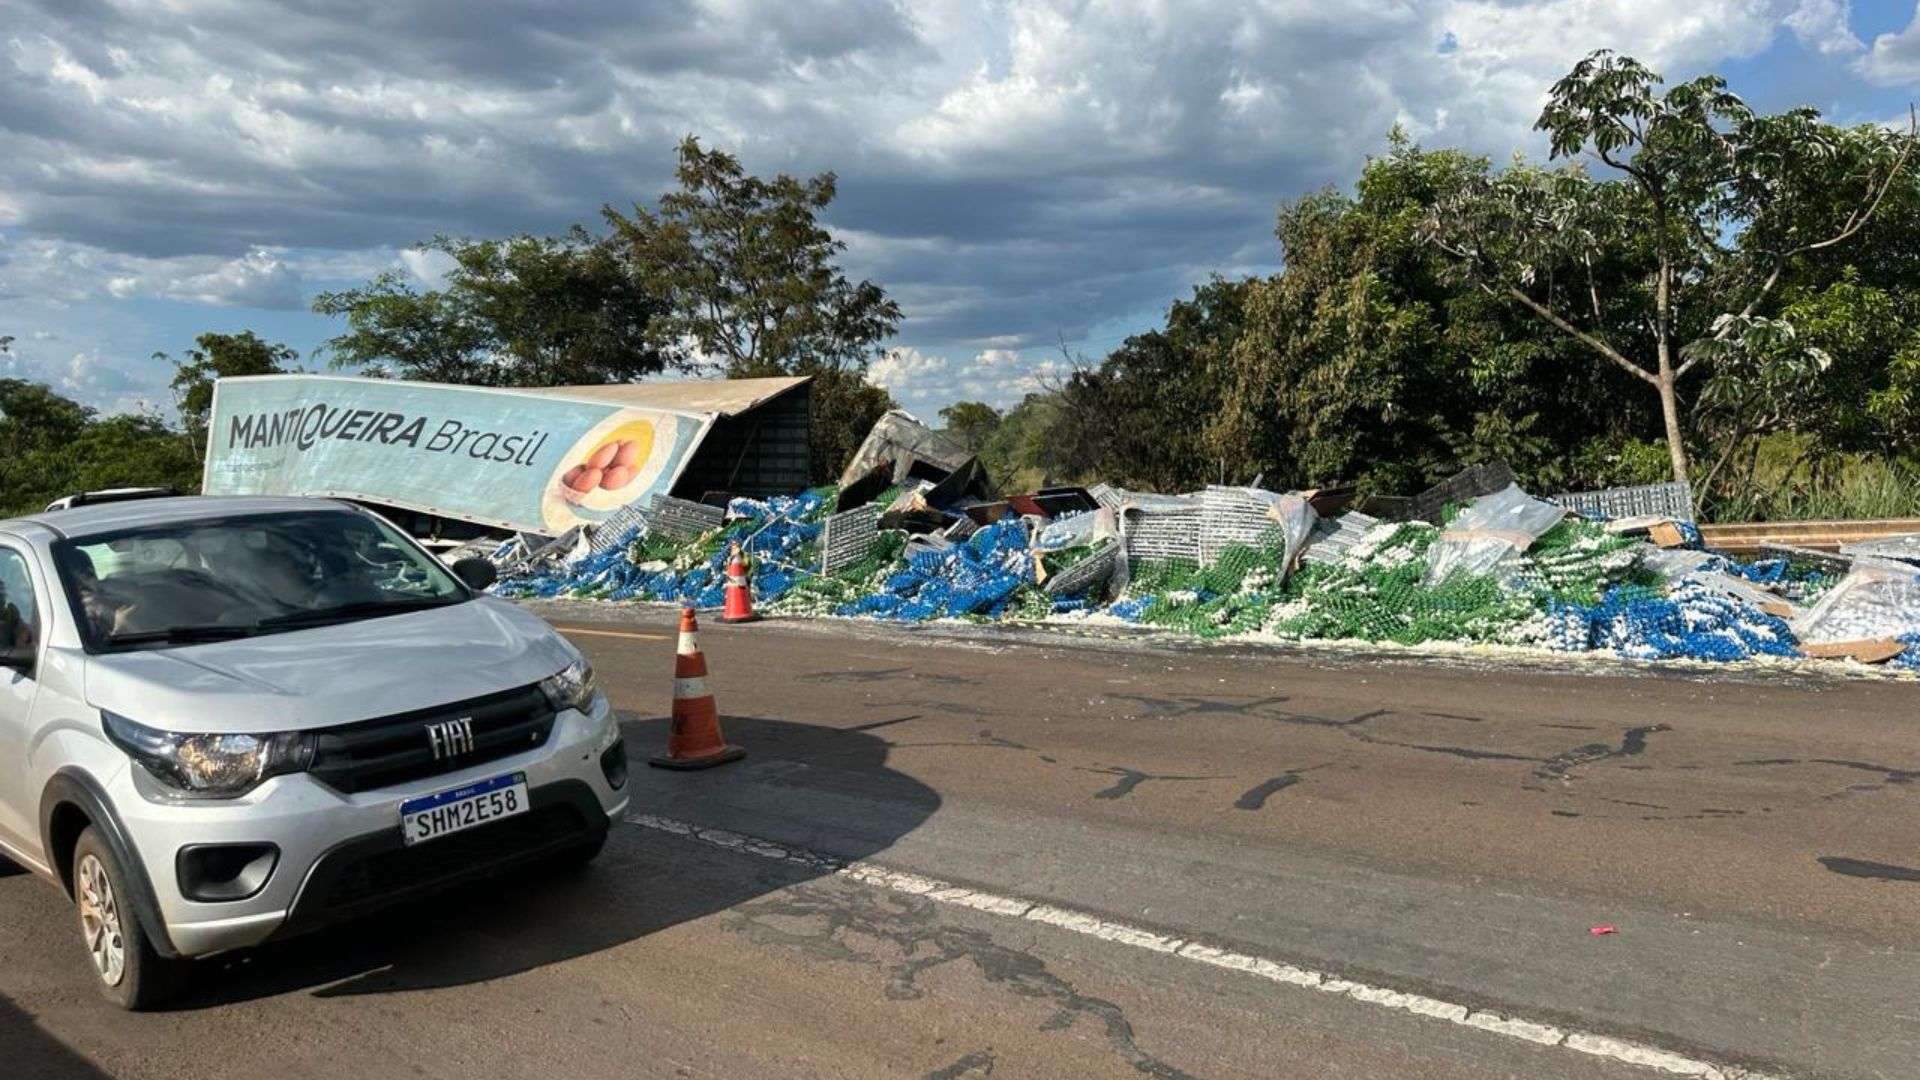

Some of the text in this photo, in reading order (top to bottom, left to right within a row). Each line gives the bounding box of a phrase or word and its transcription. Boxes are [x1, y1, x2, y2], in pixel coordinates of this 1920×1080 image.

[229, 403, 549, 466] MANTIQUEIRA Brasil
[425, 716, 475, 760] FIAT
[416, 789, 518, 838] SHM2E58
